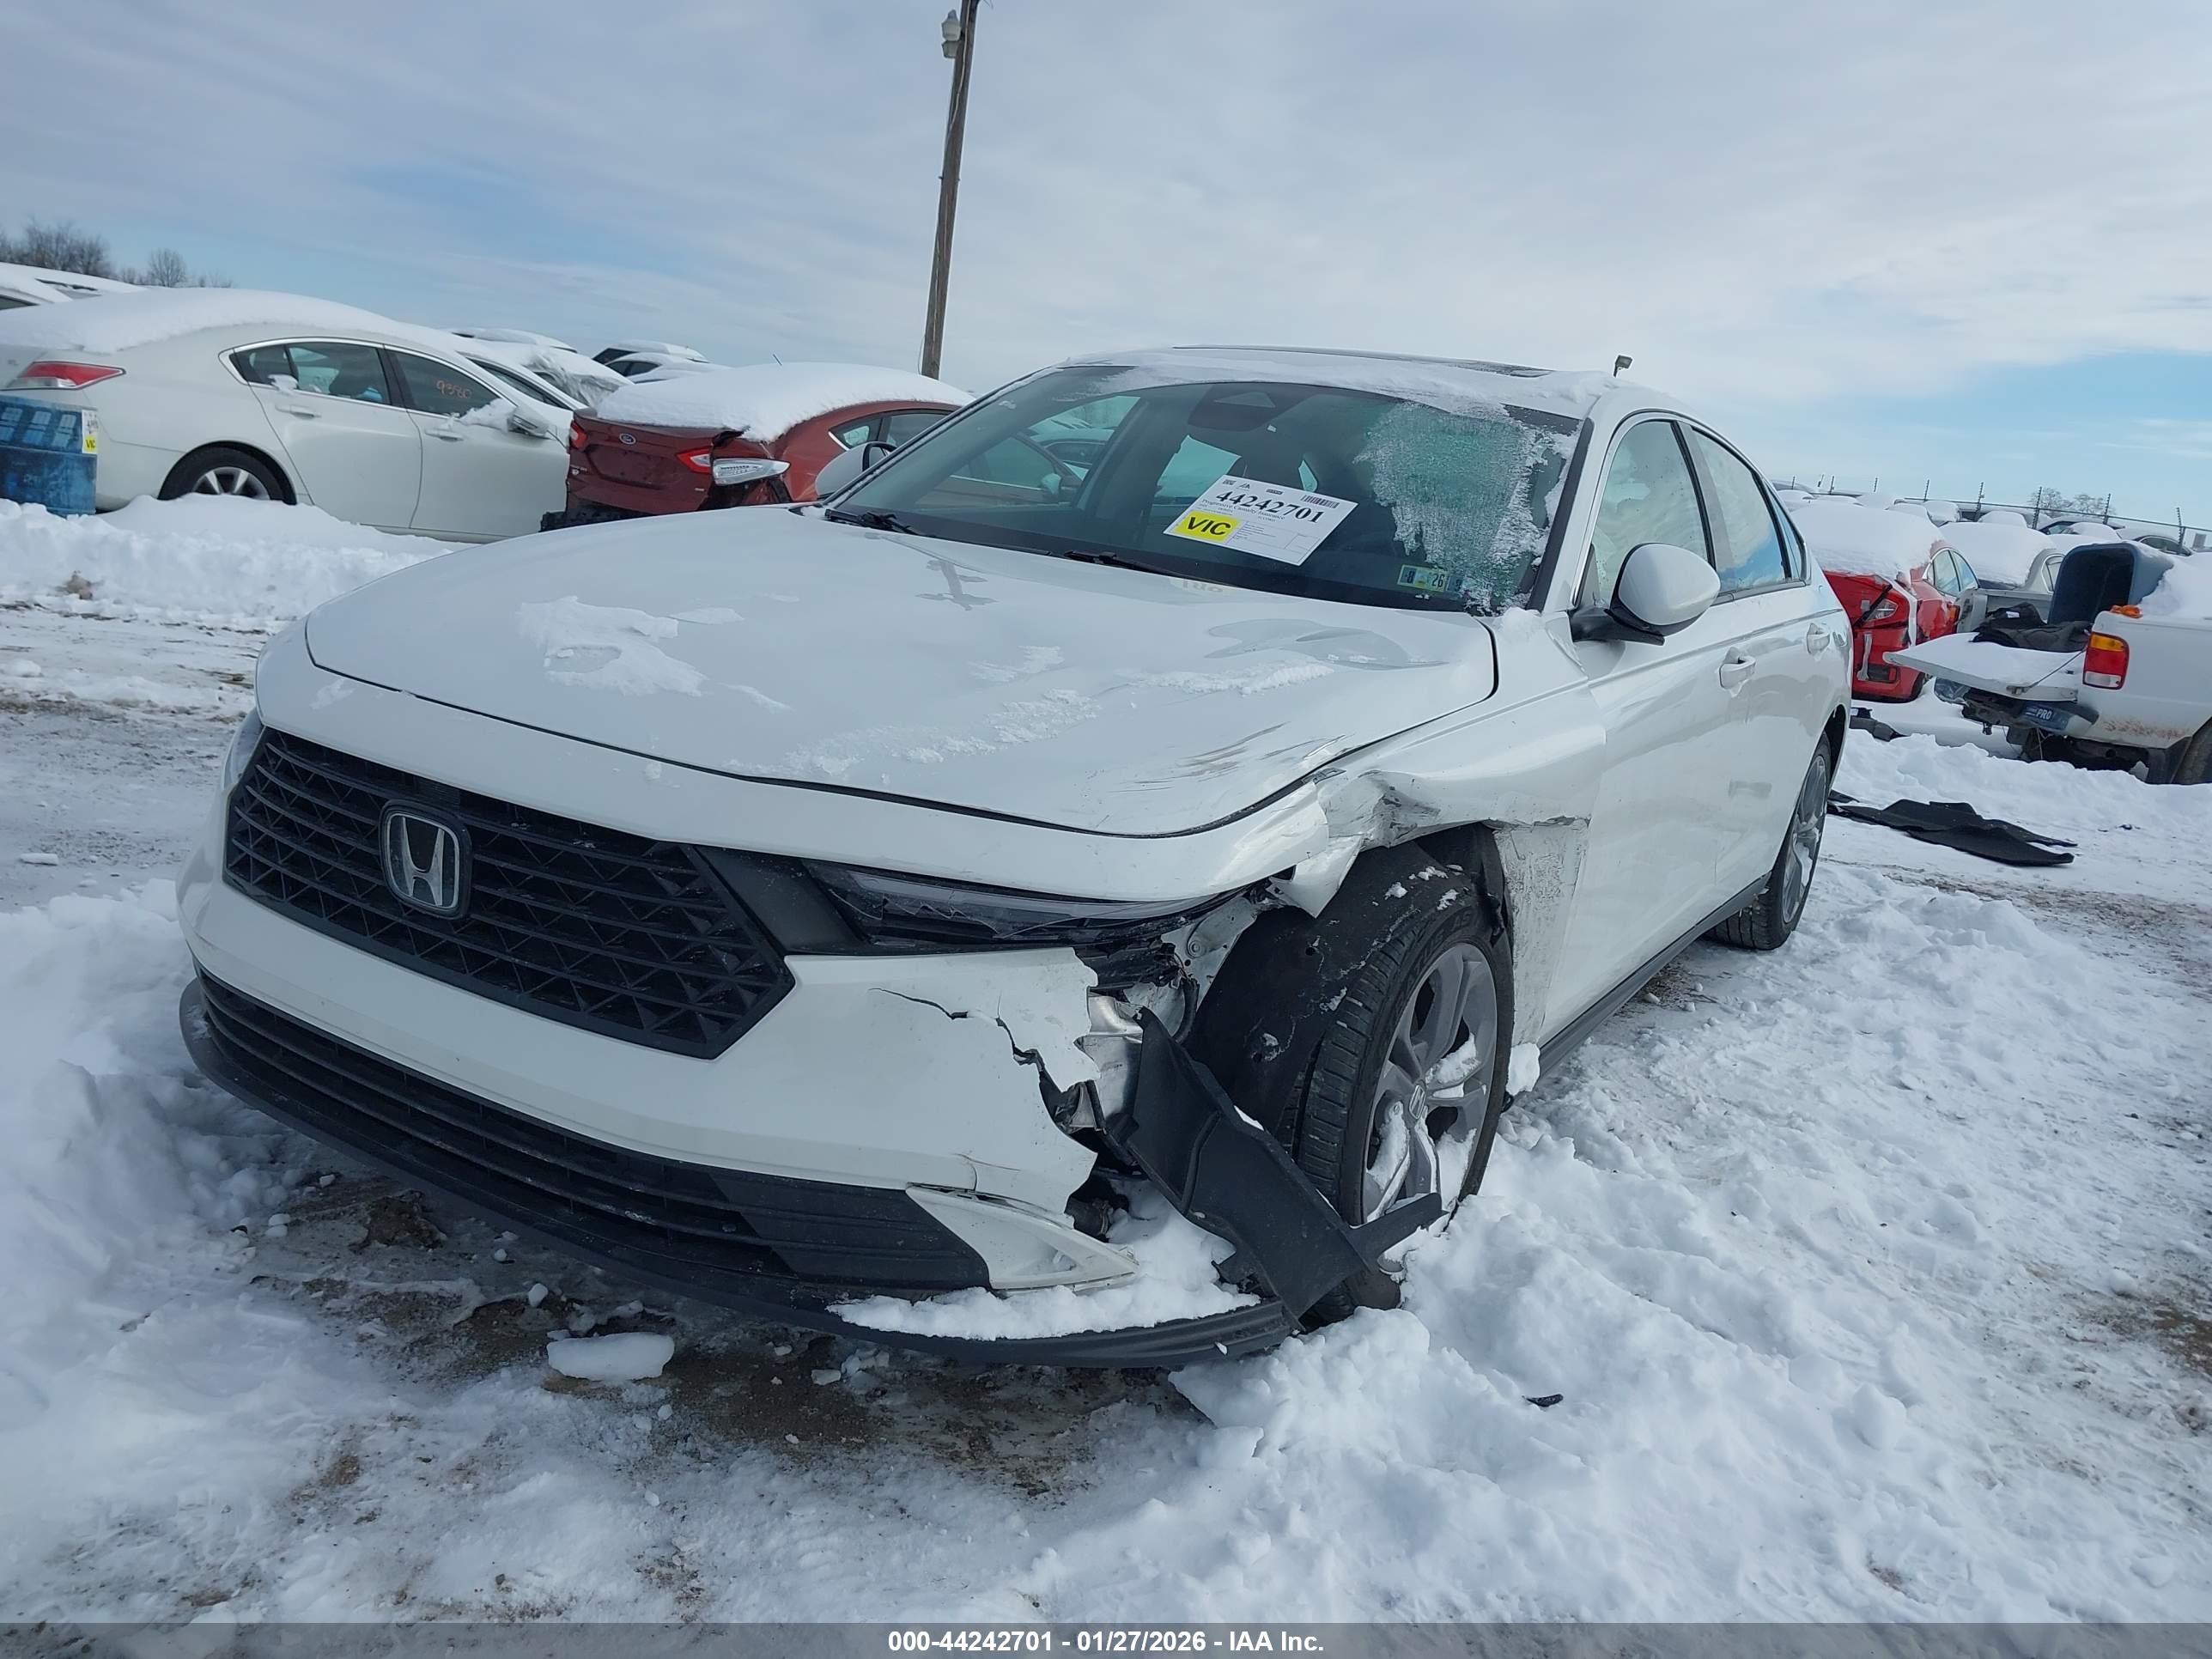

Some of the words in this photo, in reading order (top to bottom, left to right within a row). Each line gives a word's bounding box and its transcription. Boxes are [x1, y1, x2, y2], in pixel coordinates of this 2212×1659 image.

[1216, 491, 1325, 523] 44242701
[1188, 517, 1231, 536] VIC
[1431, 574, 1445, 587] 26
[2036, 708, 2053, 720] PRO
